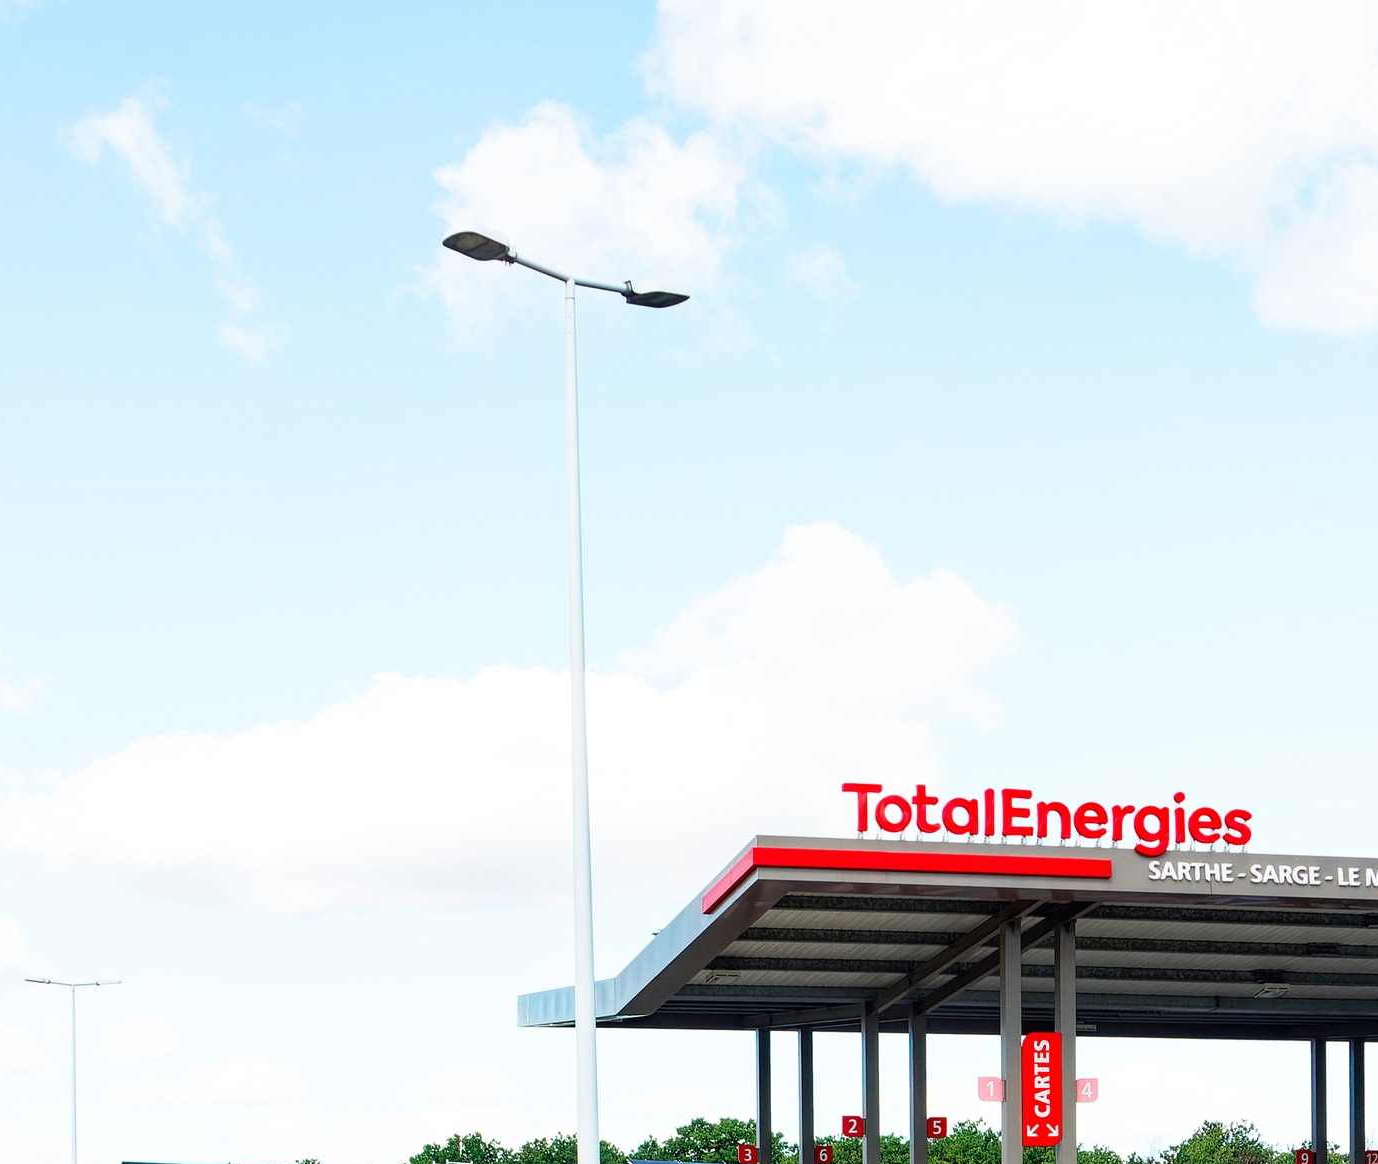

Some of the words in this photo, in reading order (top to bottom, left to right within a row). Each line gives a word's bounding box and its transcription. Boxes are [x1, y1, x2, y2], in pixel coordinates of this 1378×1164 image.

[841, 782, 1252, 857] TotalEnergies
[1148, 860, 1234, 883] SARTHE
[1250, 863, 1321, 886] SARGE
[1337, 866, 1361, 887] LE
[1033, 1039, 1051, 1118] CARTES
[986, 1080, 995, 1098] 1
[1081, 1082, 1094, 1099] 4
[848, 1118, 858, 1134] 2
[932, 1120, 942, 1135] 5
[744, 1148, 753, 1162] 3
[819, 1149, 828, 1162] 6
[1300, 1153, 1310, 1164] 9
